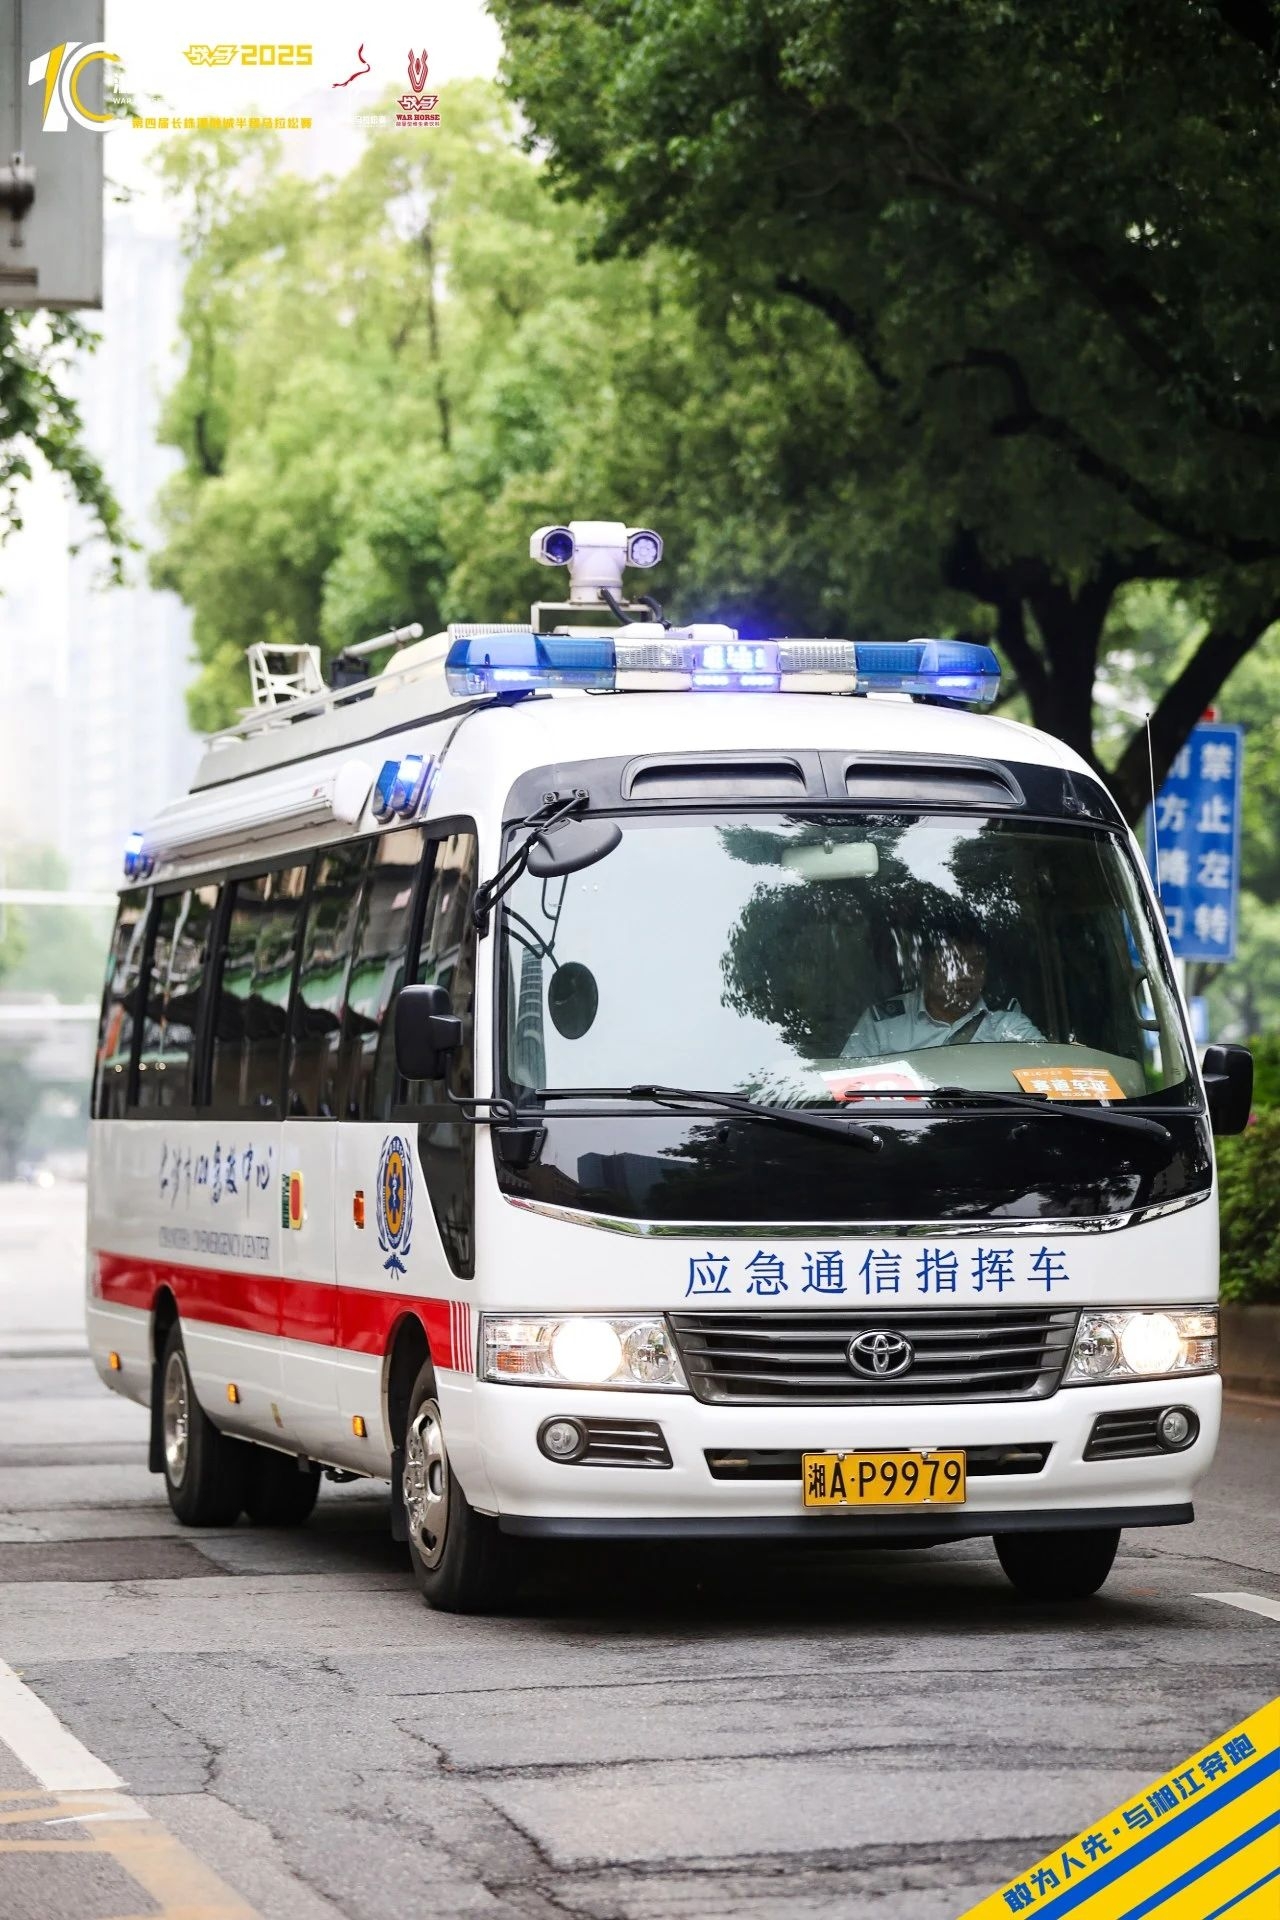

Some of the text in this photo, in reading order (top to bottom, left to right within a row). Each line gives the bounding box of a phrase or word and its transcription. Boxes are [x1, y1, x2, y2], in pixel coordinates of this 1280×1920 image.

[685, 1246, 1071, 1298] 应急通信指挥车
